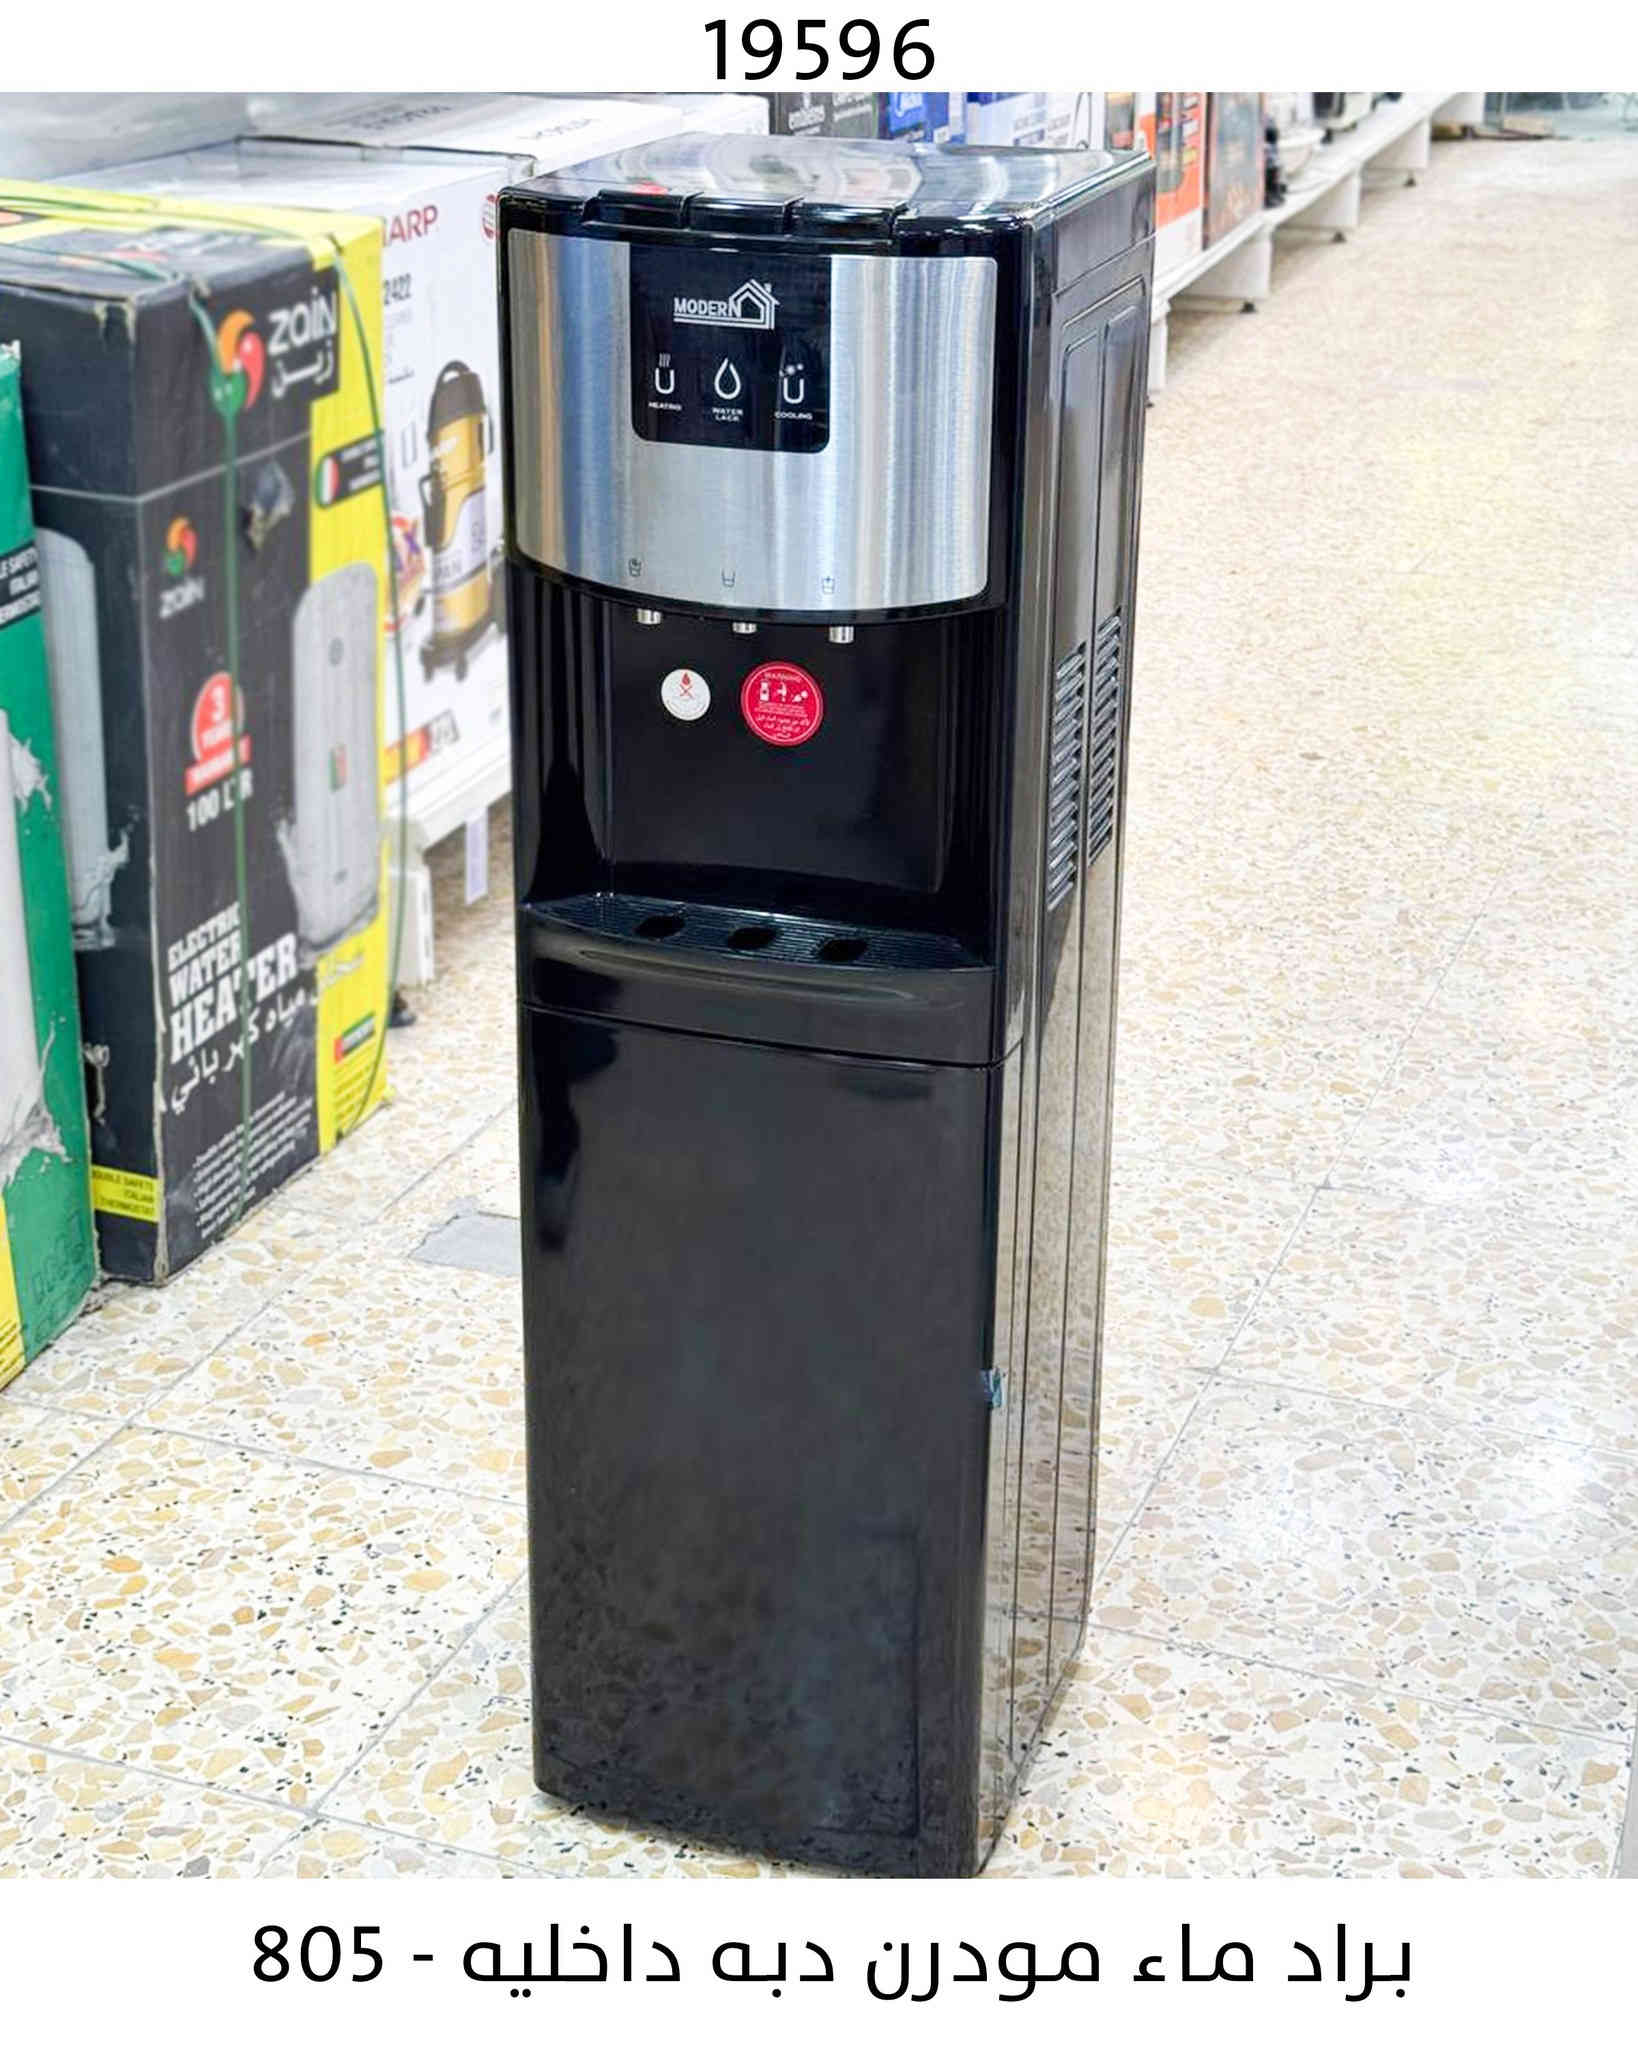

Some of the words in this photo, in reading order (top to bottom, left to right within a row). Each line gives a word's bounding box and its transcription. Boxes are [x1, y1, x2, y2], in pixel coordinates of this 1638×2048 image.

[674, 296, 741, 319] MODERN
[648, 402, 683, 412] HEATING
[712, 407, 744, 417] WATER
[775, 412, 813, 421] COOLING
